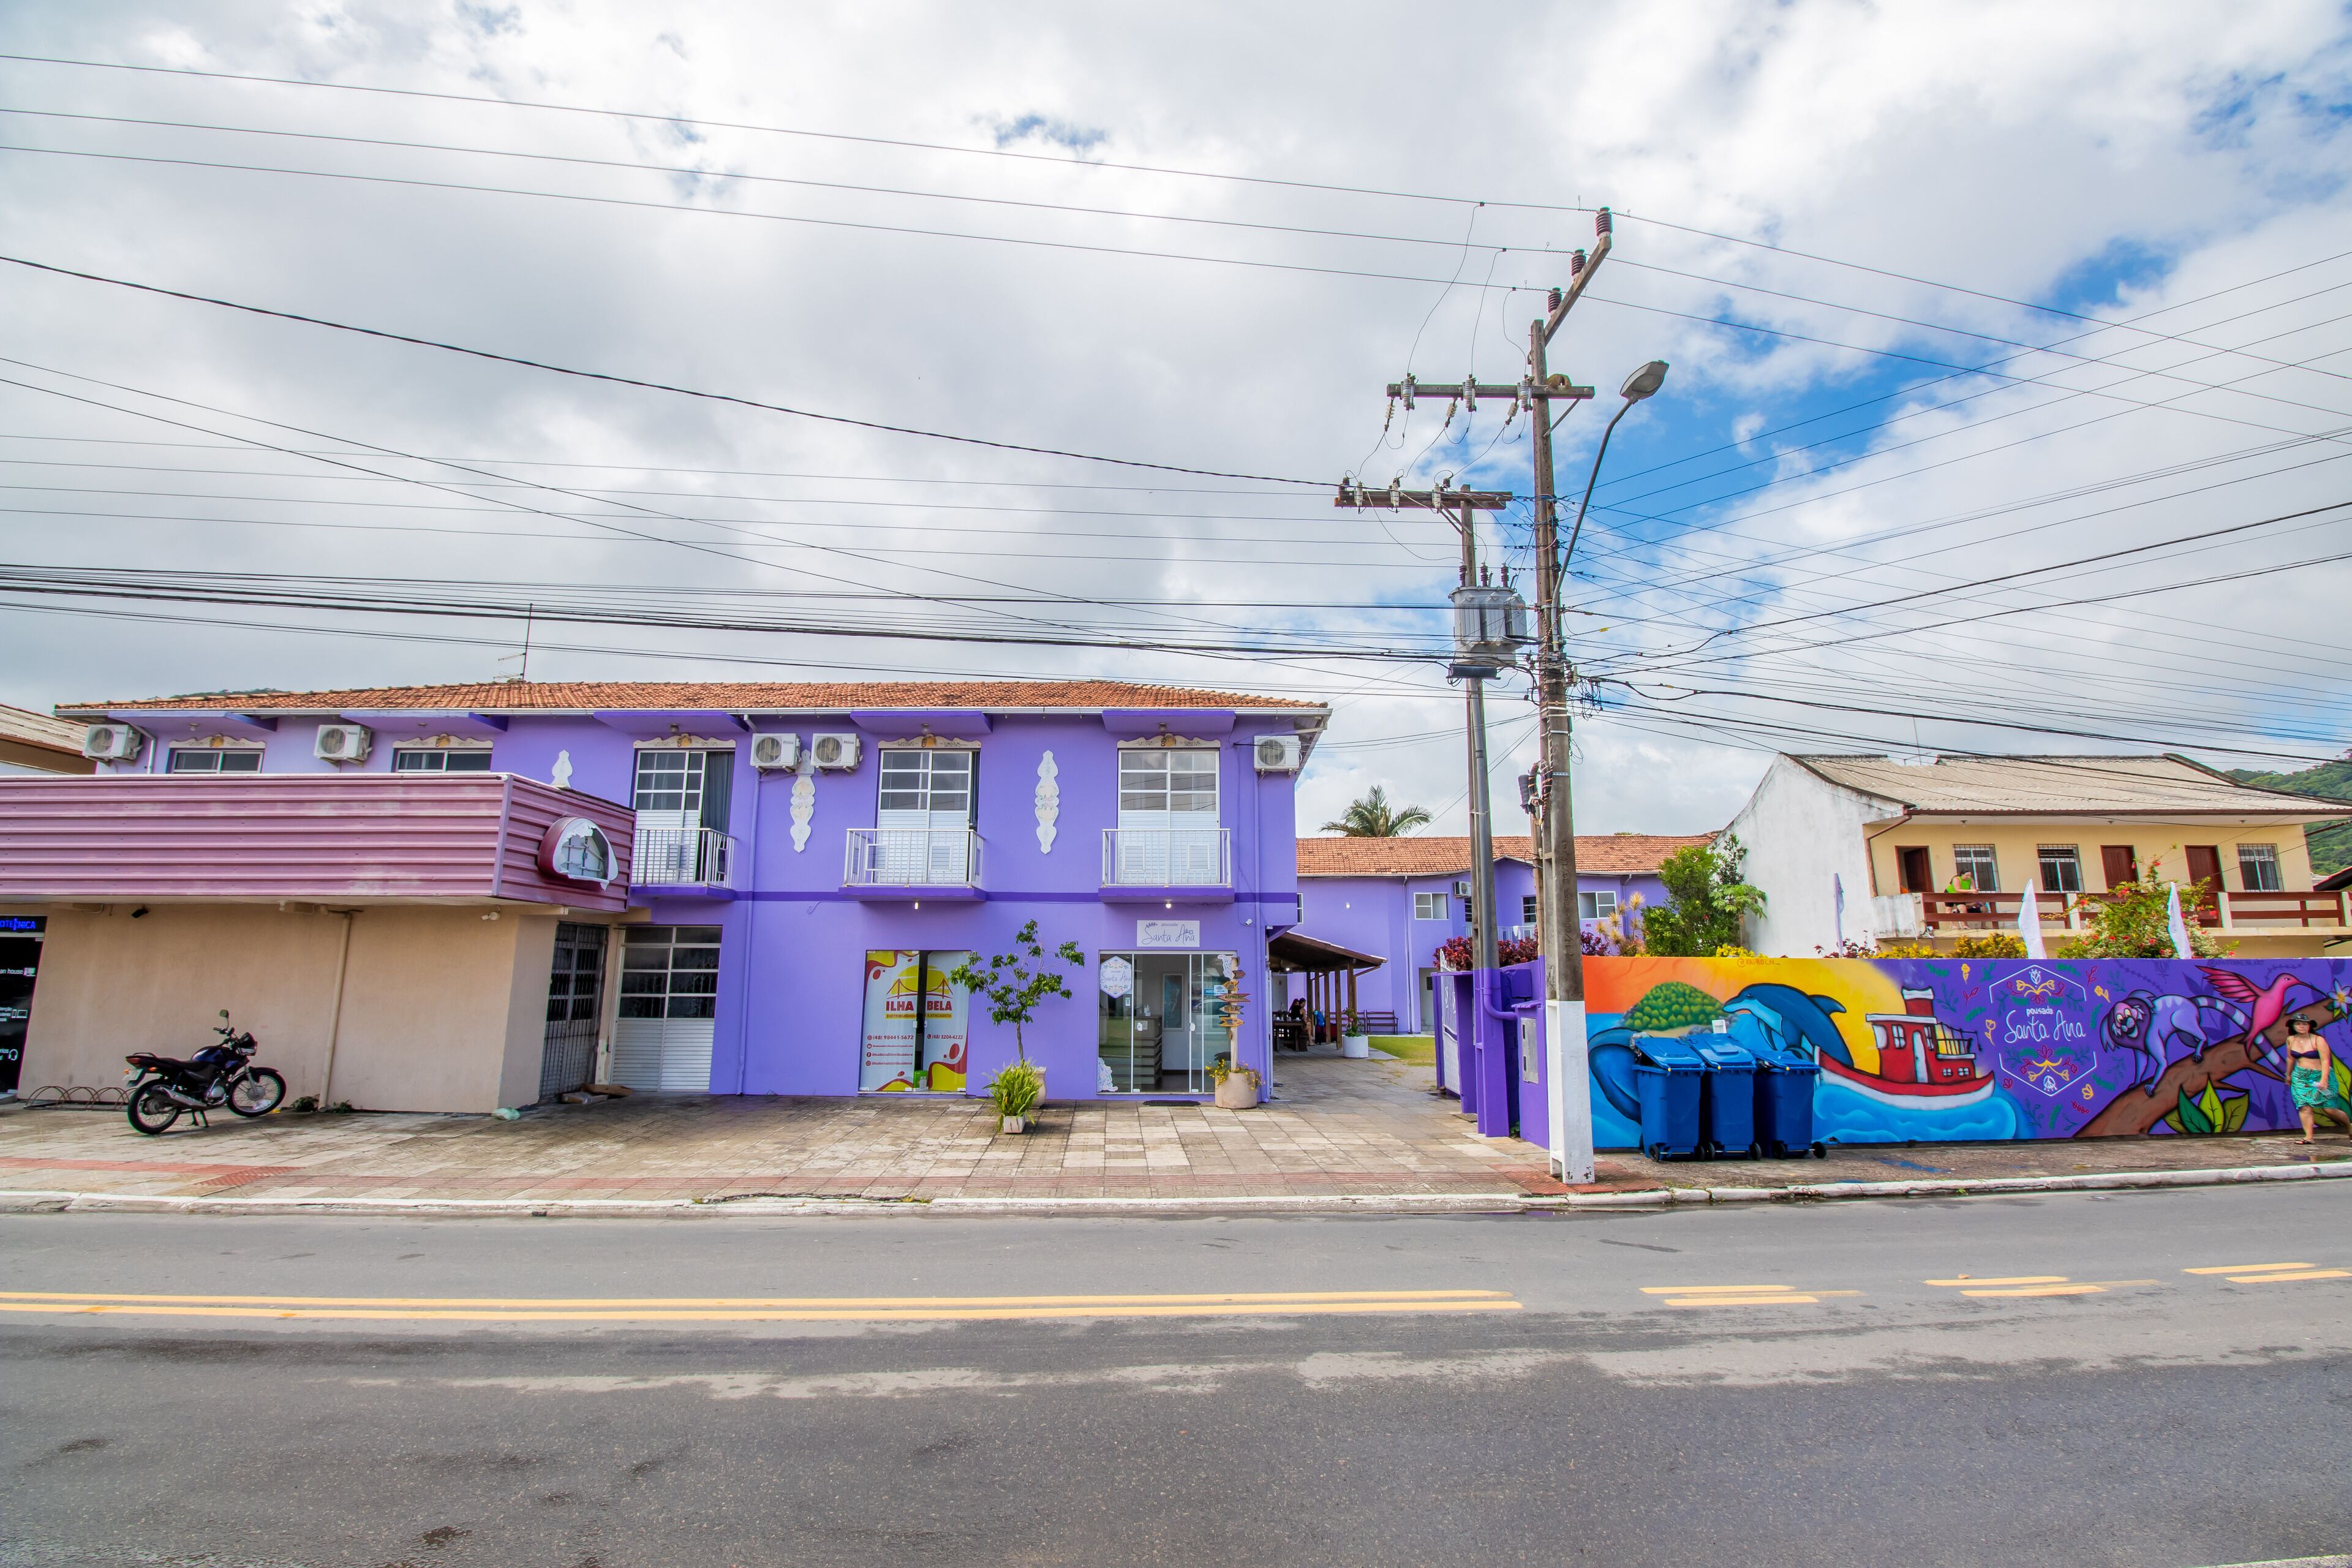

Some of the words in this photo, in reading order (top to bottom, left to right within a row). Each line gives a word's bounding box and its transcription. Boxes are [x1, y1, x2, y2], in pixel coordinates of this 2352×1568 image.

[1142, 923, 1171, 944] Santa
[1175, 924, 1195, 944] Ana
[886, 1000, 914, 1011] ILHA
[927, 1000, 952, 1010] BELA
[2026, 1005, 2053, 1017] pousada
[2004, 1009, 2049, 1043] Santa
[2053, 1009, 2086, 1041] Ana
